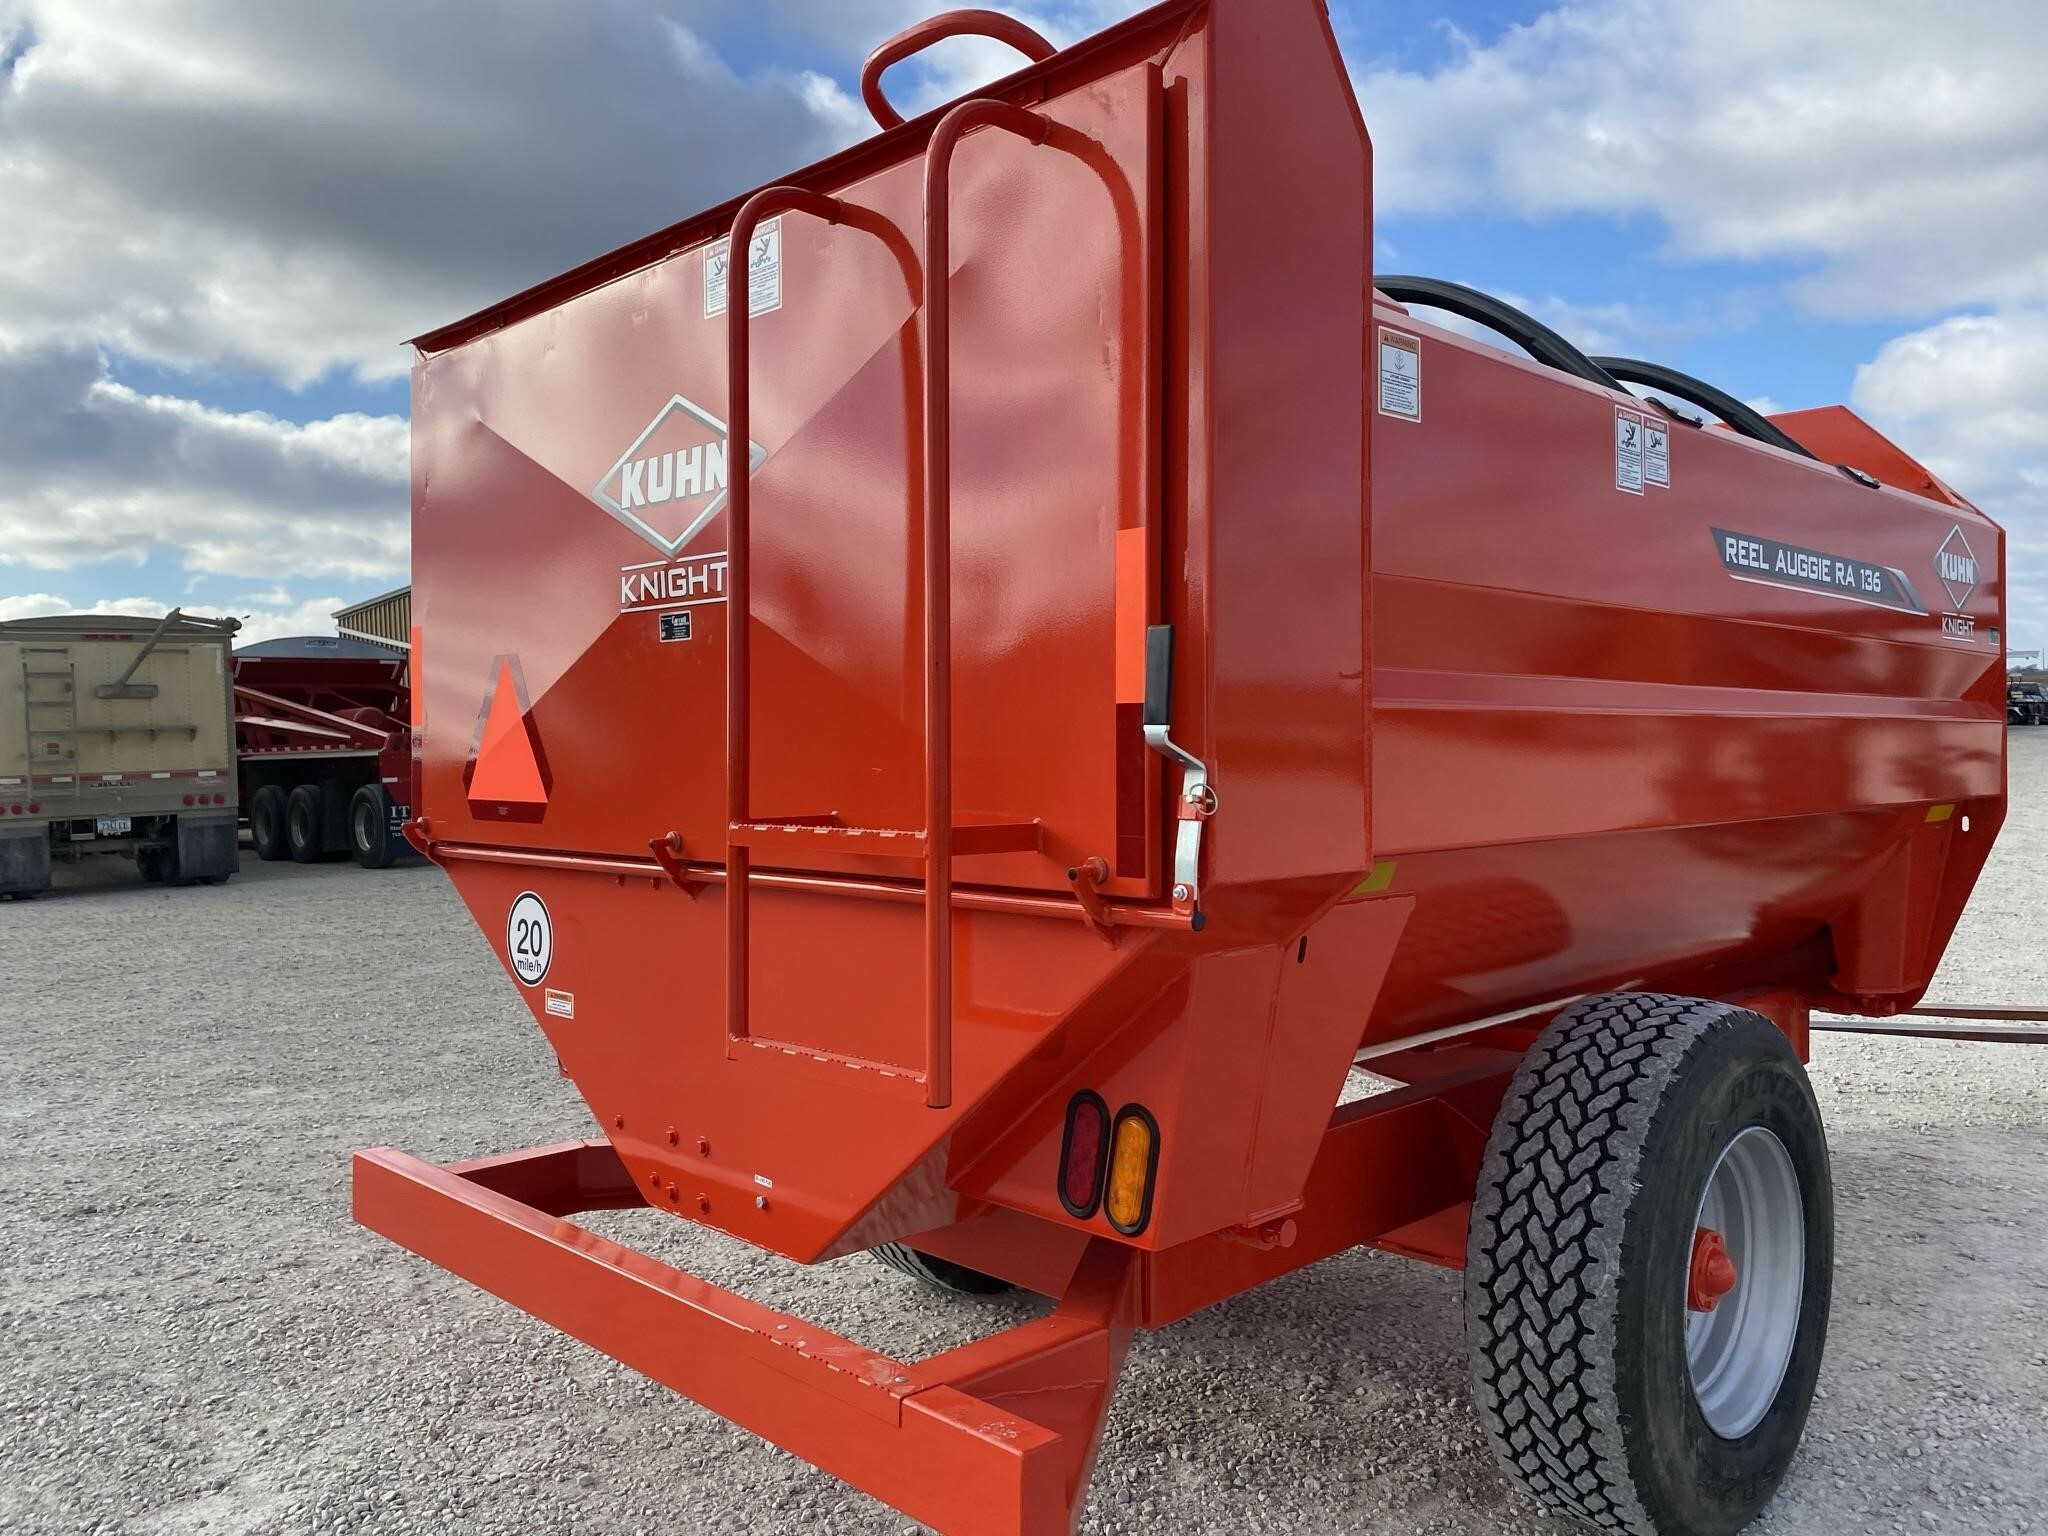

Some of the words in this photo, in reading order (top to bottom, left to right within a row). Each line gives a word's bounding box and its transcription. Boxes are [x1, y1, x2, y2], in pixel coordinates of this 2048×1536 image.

[620, 439, 728, 510] KUHN
[620, 561, 728, 604] KNIGHT
[1725, 536, 1770, 570] REEL
[1775, 549, 1831, 583] AUGGIE
[1836, 562, 1855, 587] RA
[1860, 569, 1881, 593] 136
[1940, 551, 1974, 585] KUHN
[1941, 616, 1975, 636] KNIGHT
[516, 918, 543, 957] 20
[517, 958, 542, 974] mile/h
